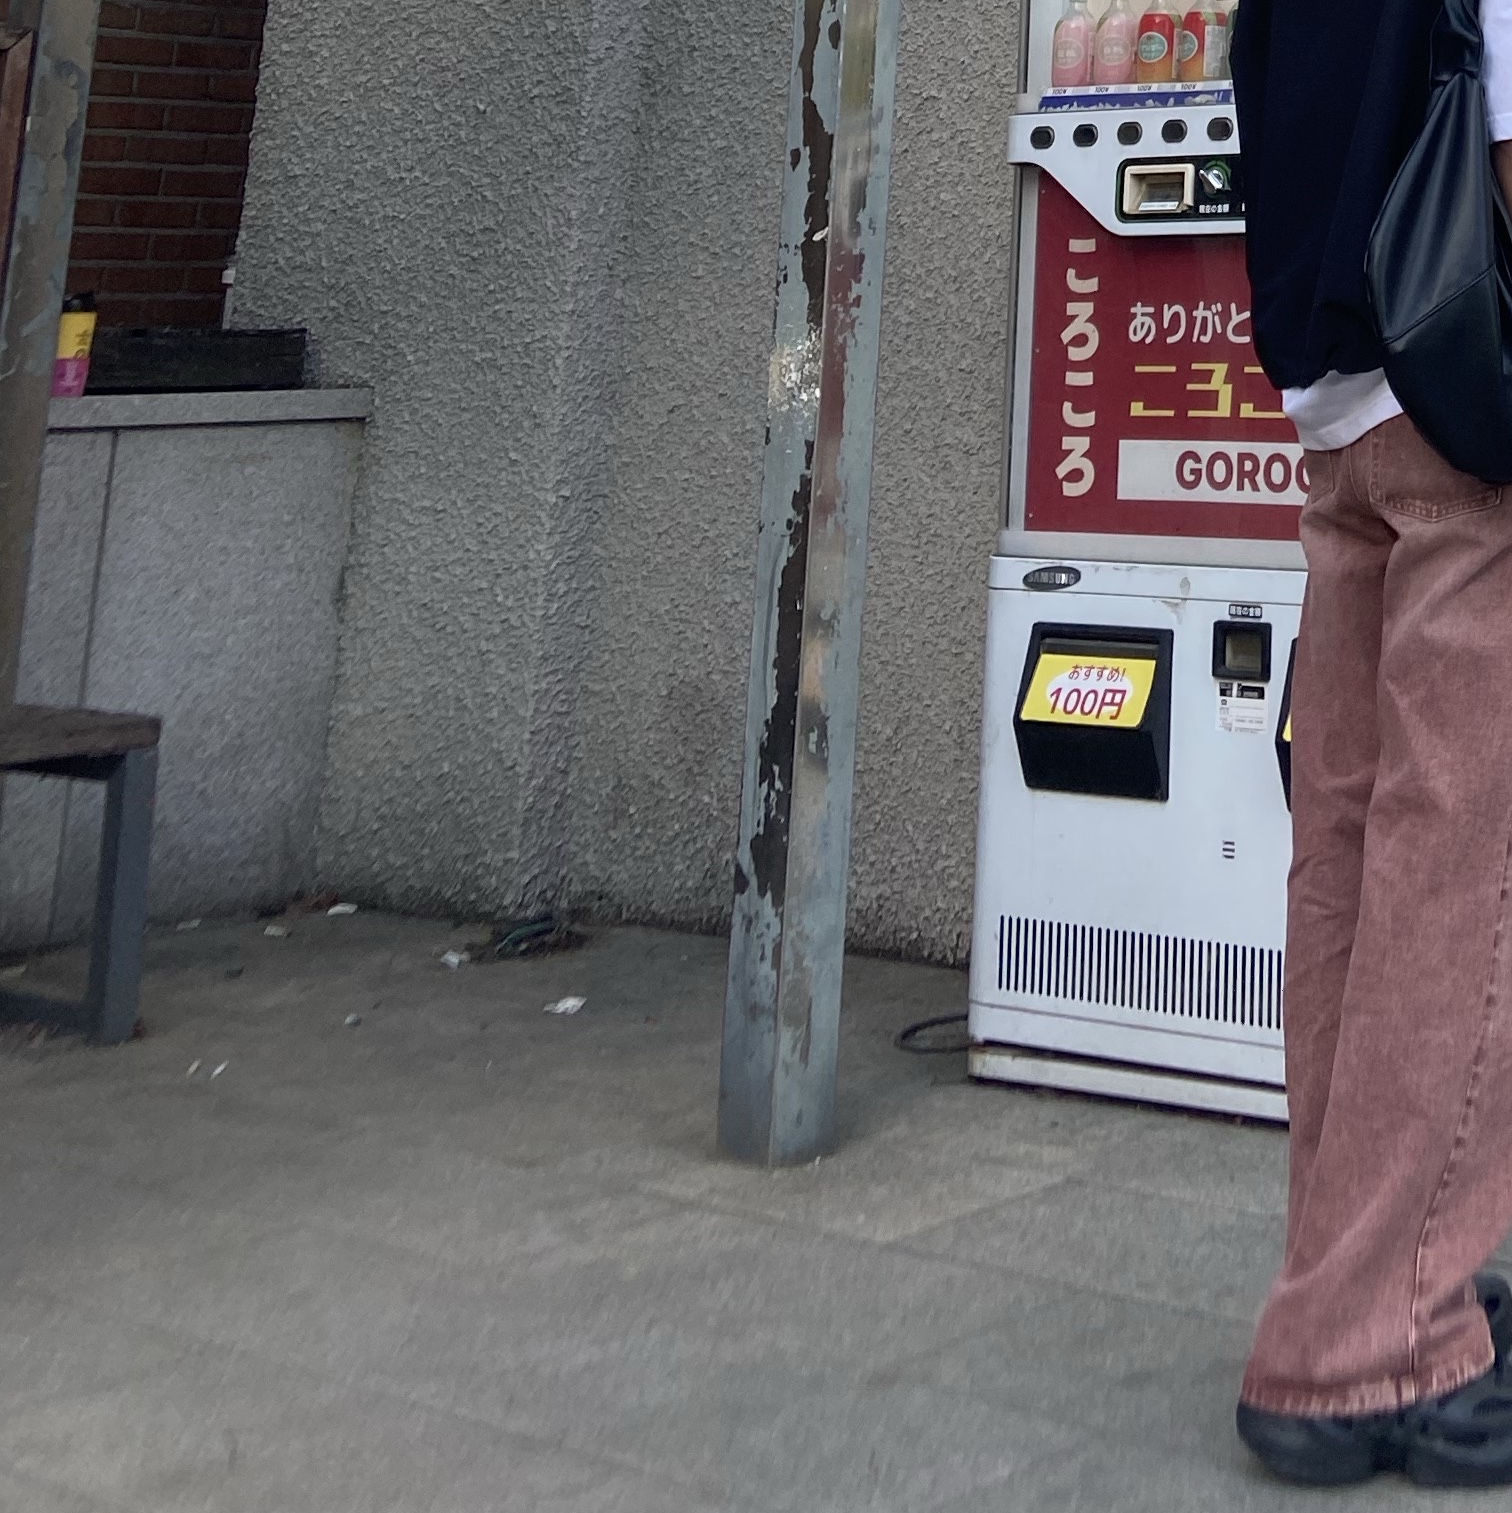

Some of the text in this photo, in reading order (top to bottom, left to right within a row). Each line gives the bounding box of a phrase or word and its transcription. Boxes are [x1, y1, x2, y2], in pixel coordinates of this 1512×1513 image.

[1129, 301, 1250, 344] ありがと
[1055, 238, 1100, 498] ころころ
[1027, 572, 1076, 585] SAMSUNG
[1049, 687, 1127, 720] 100円
